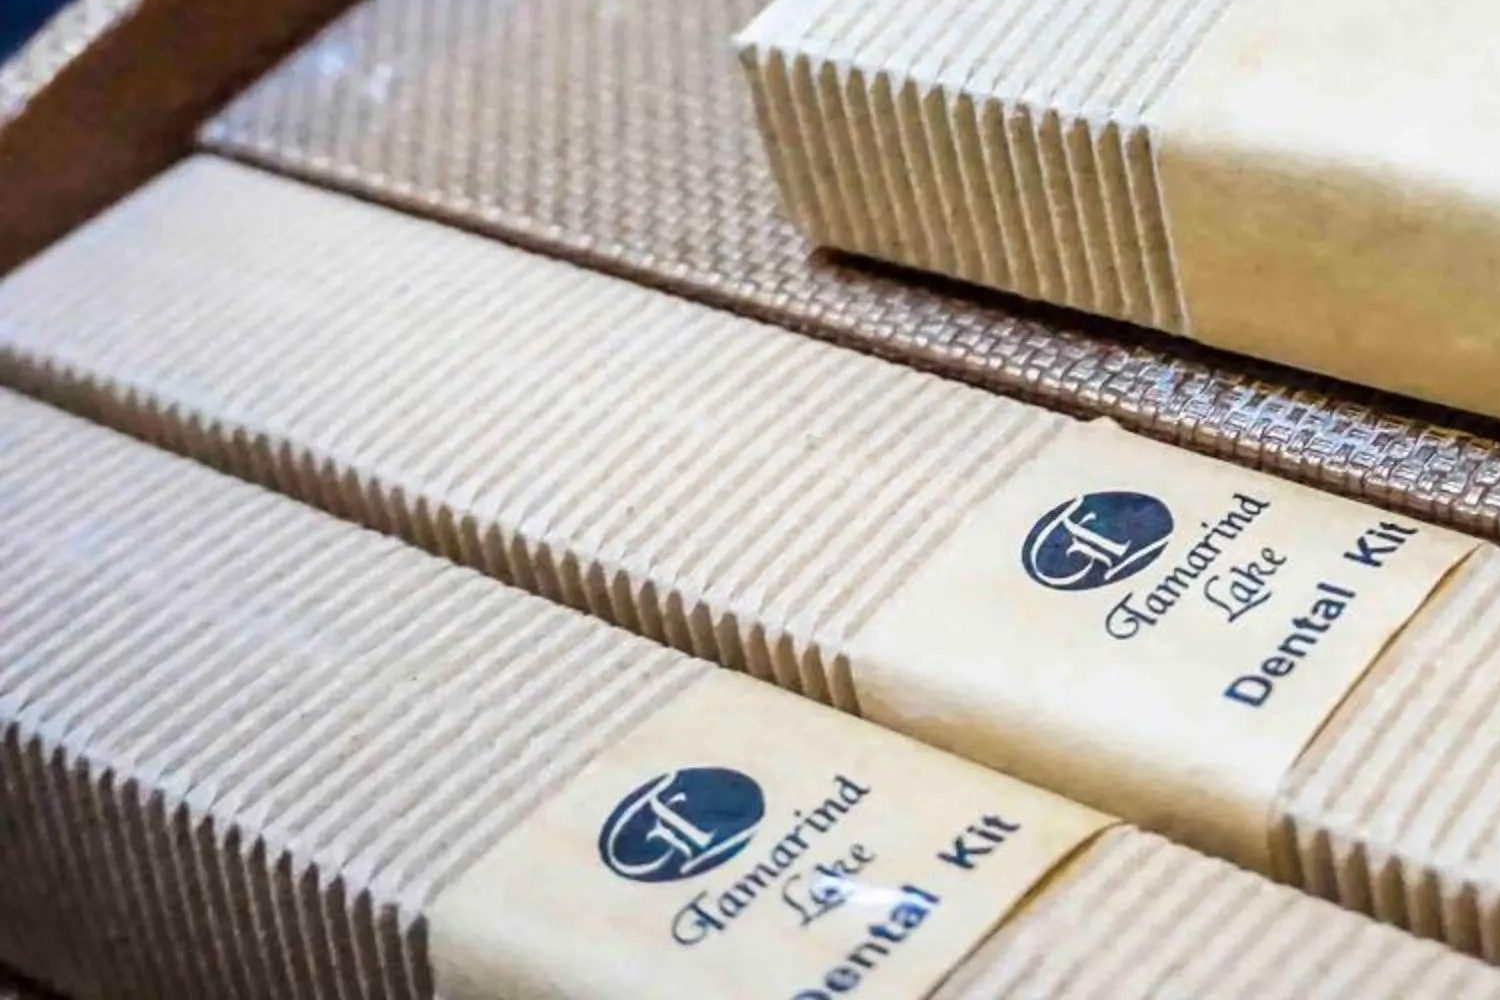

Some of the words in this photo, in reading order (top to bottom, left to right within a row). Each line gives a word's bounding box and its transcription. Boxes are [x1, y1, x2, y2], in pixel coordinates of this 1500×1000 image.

[1104, 492, 1271, 641] Tamarind
[1203, 546, 1287, 622] Lake
[1223, 582, 1356, 708] Dental
[1343, 520, 1420, 568] Kit
[670, 773, 871, 946] Tamarind
[935, 812, 1022, 872] Kit
